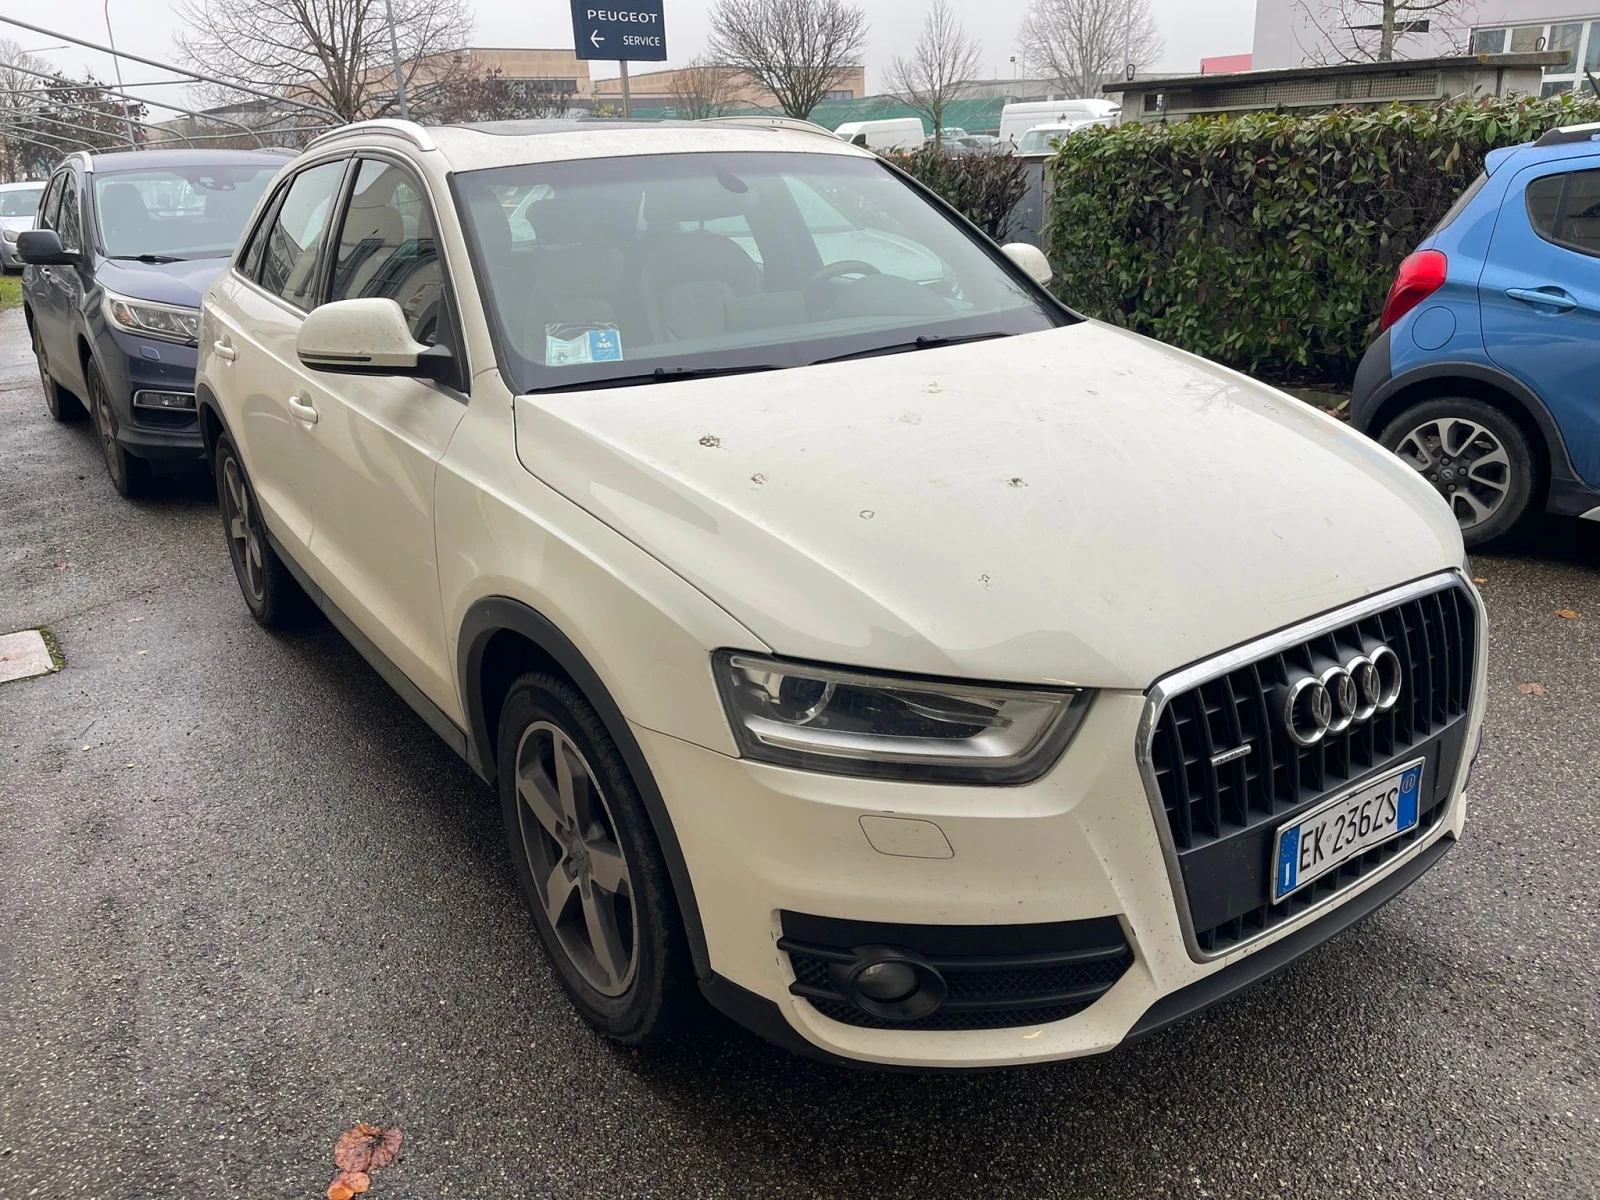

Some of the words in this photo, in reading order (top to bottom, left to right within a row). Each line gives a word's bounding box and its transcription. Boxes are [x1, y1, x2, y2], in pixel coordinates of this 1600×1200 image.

[587, 9, 658, 23] PEUGEOT
[623, 35, 660, 46] SERVICE
[1299, 822, 1327, 873] EK
[1331, 786, 1398, 855] 236ZS
